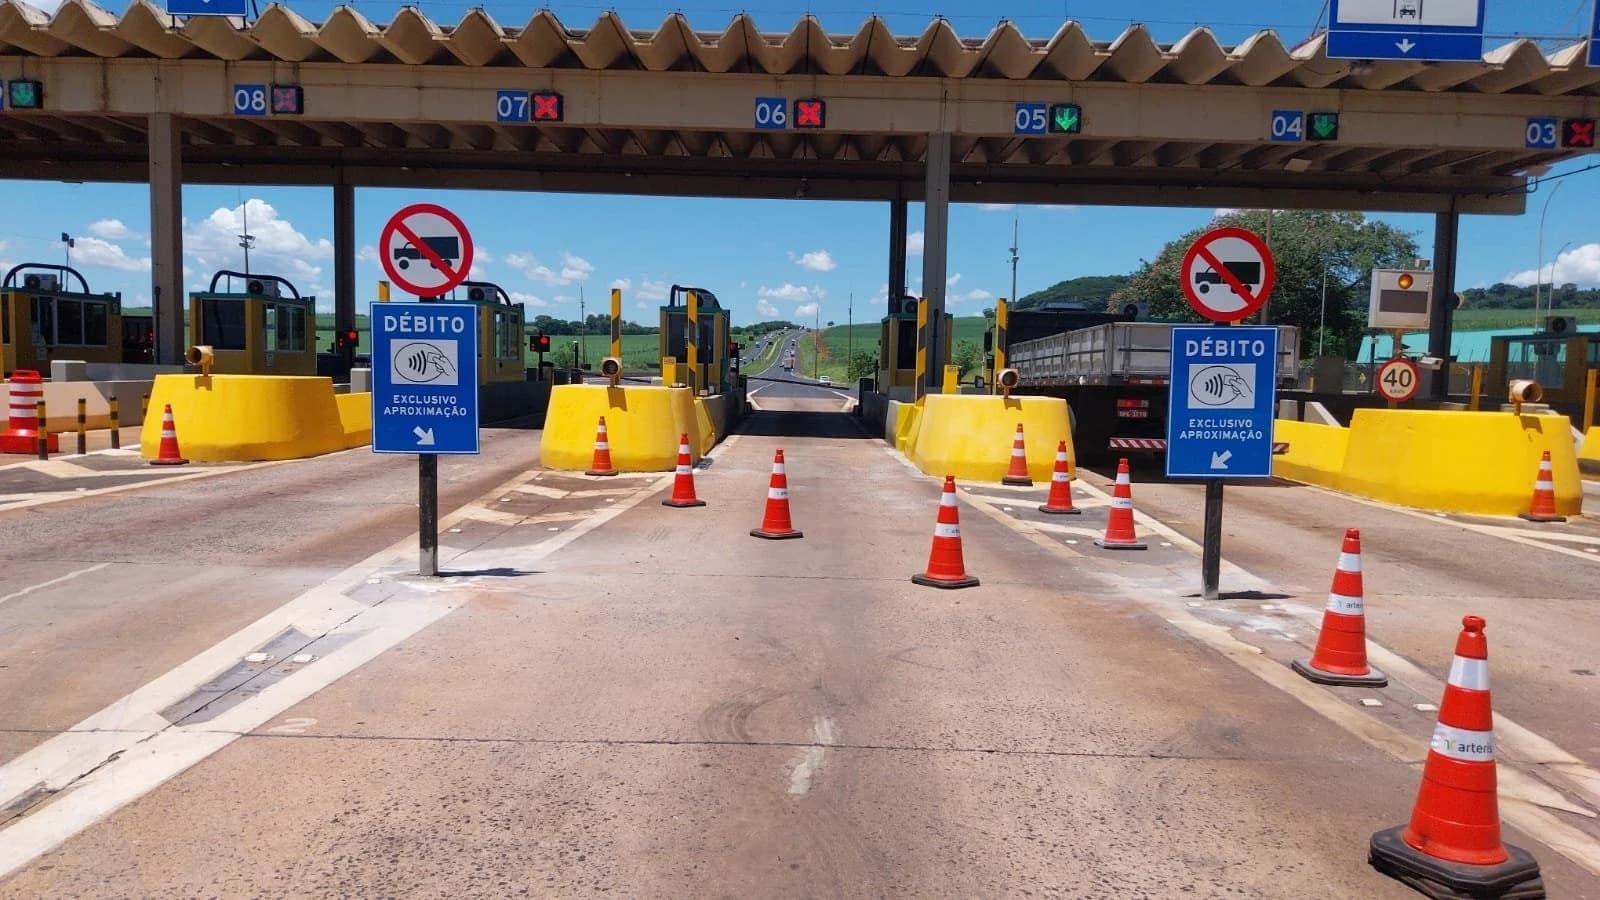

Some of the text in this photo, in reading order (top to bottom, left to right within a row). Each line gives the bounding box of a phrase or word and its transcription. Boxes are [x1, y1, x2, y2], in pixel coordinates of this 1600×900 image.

[234, 89, 265, 111] 08
[497, 95, 528, 117] 07
[755, 103, 786, 124] 06
[1015, 108, 1046, 130] 05
[1272, 115, 1302, 138] 04
[1526, 123, 1556, 144] 03
[384, 312, 465, 333] DÉBITO
[1185, 336, 1265, 357] DÉBITO
[1383, 369, 1412, 387] 40
[393, 394, 457, 404] EXCLUSIVO
[383, 405, 467, 418] APROXIMAÇÃO
[1189, 418, 1252, 428] EXCLUSIVO
[1179, 429, 1263, 442] APROXIMAÇÃO
